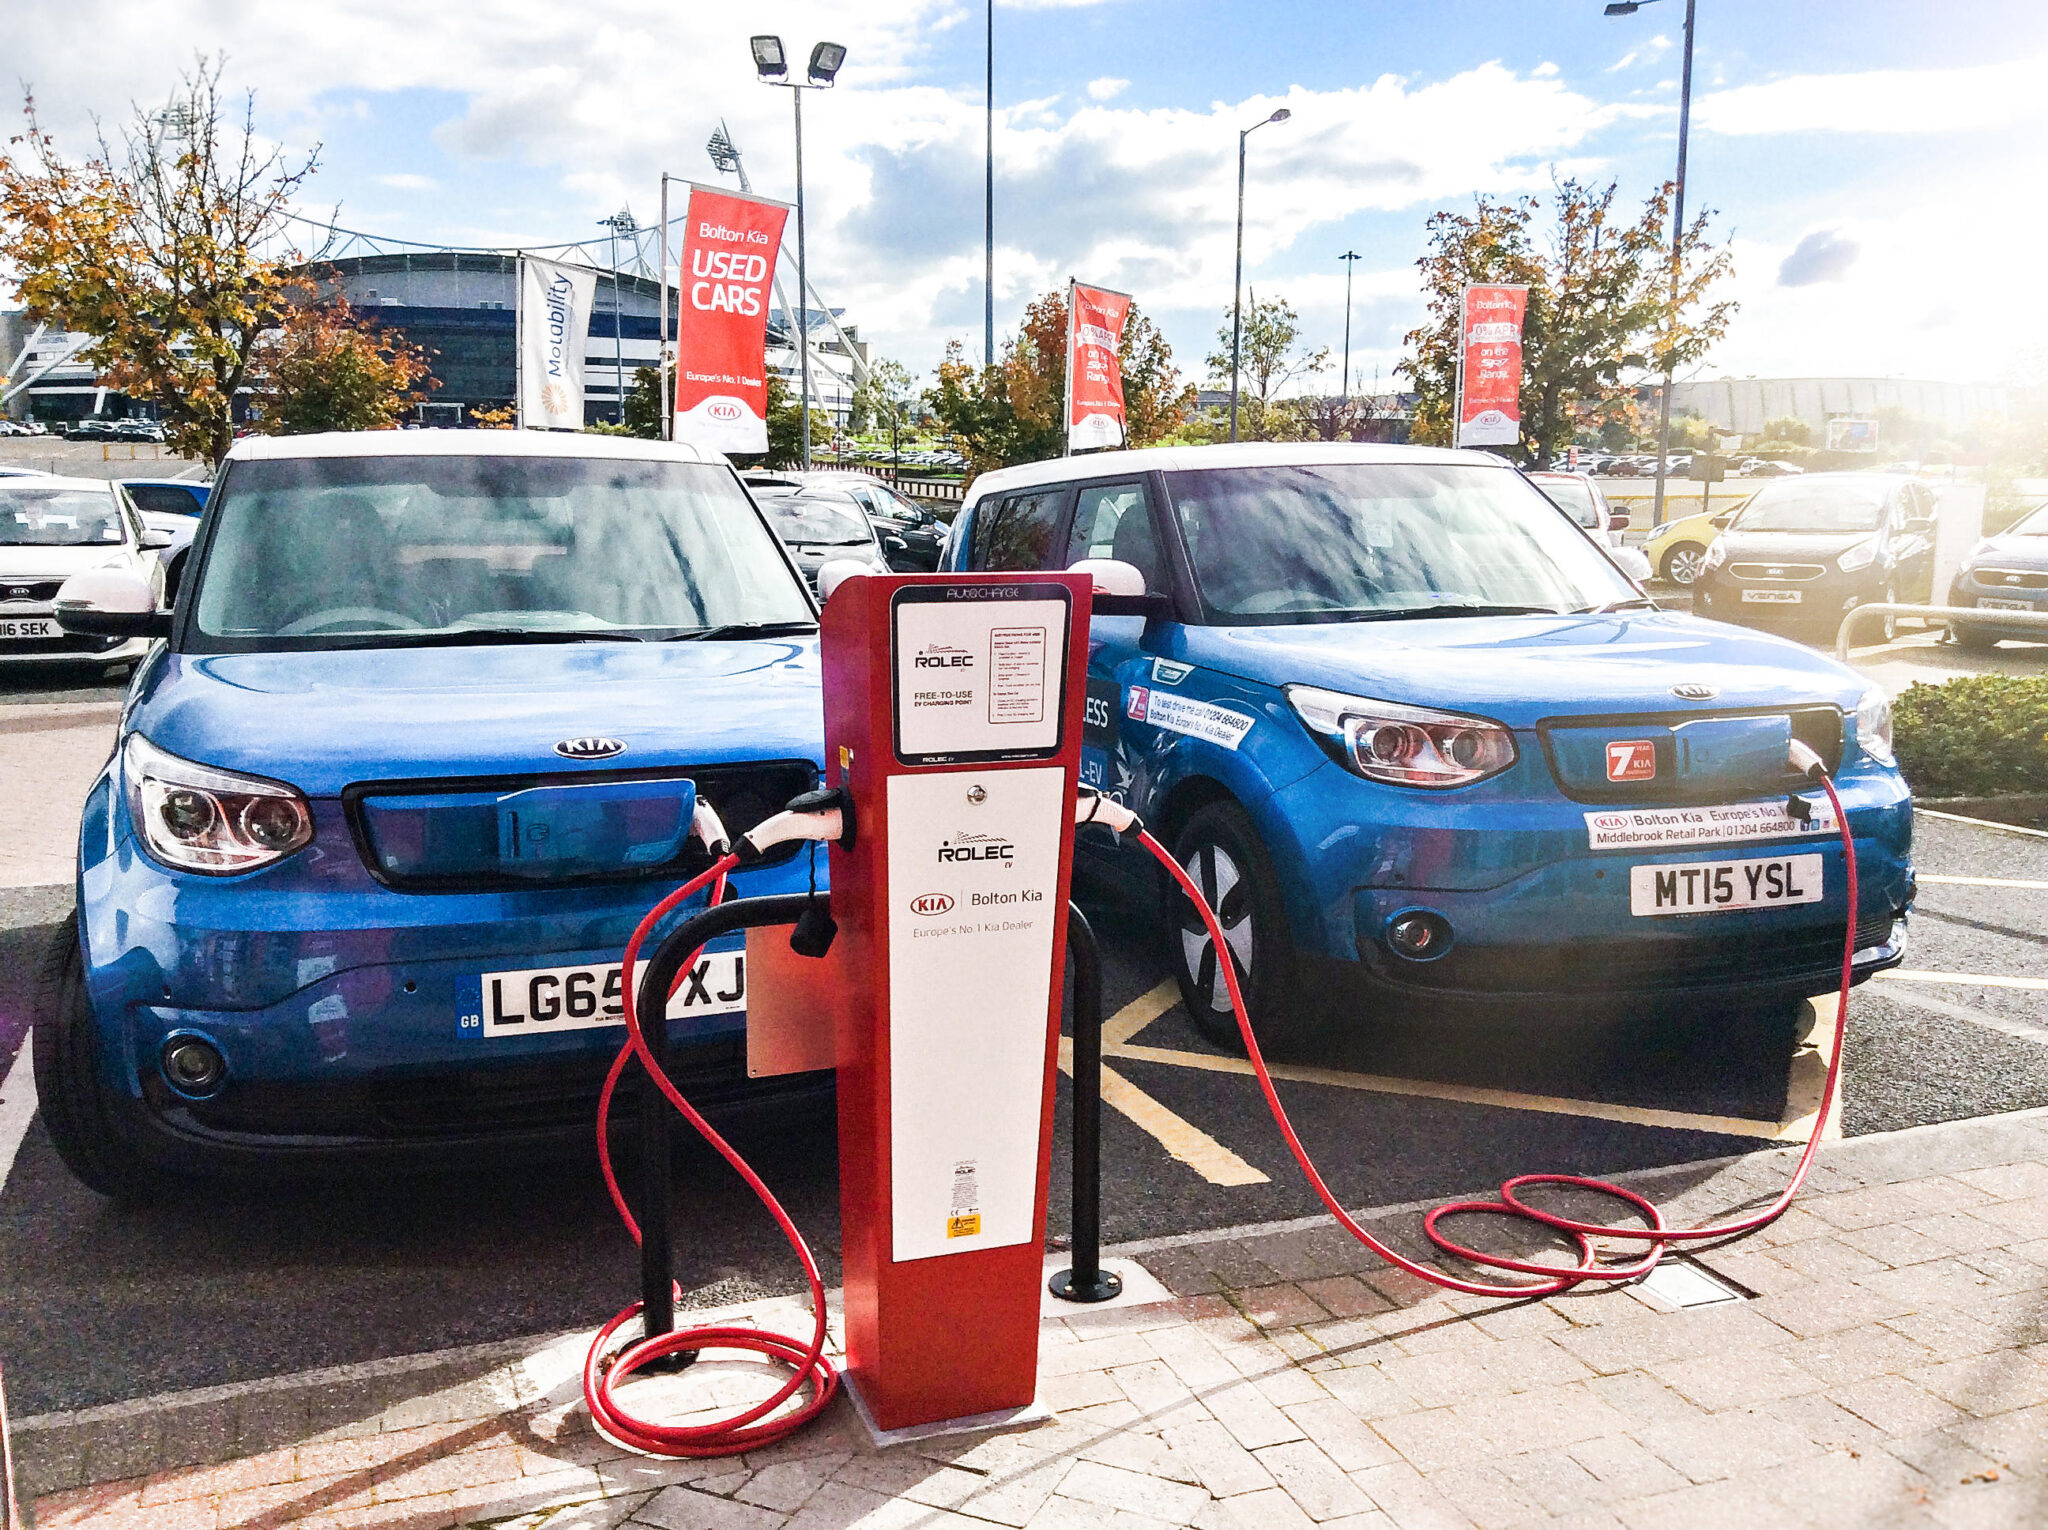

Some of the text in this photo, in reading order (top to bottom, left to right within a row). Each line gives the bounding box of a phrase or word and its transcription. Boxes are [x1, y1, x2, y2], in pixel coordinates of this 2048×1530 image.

[699, 222, 769, 245] Bolton Kia
[692, 248, 767, 283] USED
[691, 281, 762, 317] CARS
[1088, 350, 1099, 359] on
[1481, 348, 1493, 357] on
[686, 371, 721, 384] Europe's
[742, 375, 762, 388] Dealer
[712, 405, 737, 418] KIA
[0, 622, 49, 636] 16 SEK
[915, 654, 974, 669] ROLEC
[914, 690, 973, 700] FREE-TO-USE
[1083, 697, 1109, 728] ESS
[561, 737, 620, 755] KIA
[1610, 746, 1636, 776] 7
[1633, 759, 1651, 769] KIA
[1598, 817, 1625, 828] KIA
[1634, 813, 1679, 826] Bolton
[1681, 811, 1704, 824] Kia
[1709, 807, 1760, 822] Europe's
[1597, 820, 1795, 843] Middlebrook Retail Park 01204 664800
[938, 844, 1014, 863] ROLEC
[1655, 861, 1804, 907] MT15 YSL
[915, 889, 1043, 913] KIA Bolton Kia
[913, 925, 957, 939] Europe's
[960, 924, 973, 935] No
[984, 922, 1000, 933] Kia
[1002, 920, 1034, 931] Dealer
[491, 957, 744, 1026] LG65 XJ
[460, 1015, 480, 1029] GB
